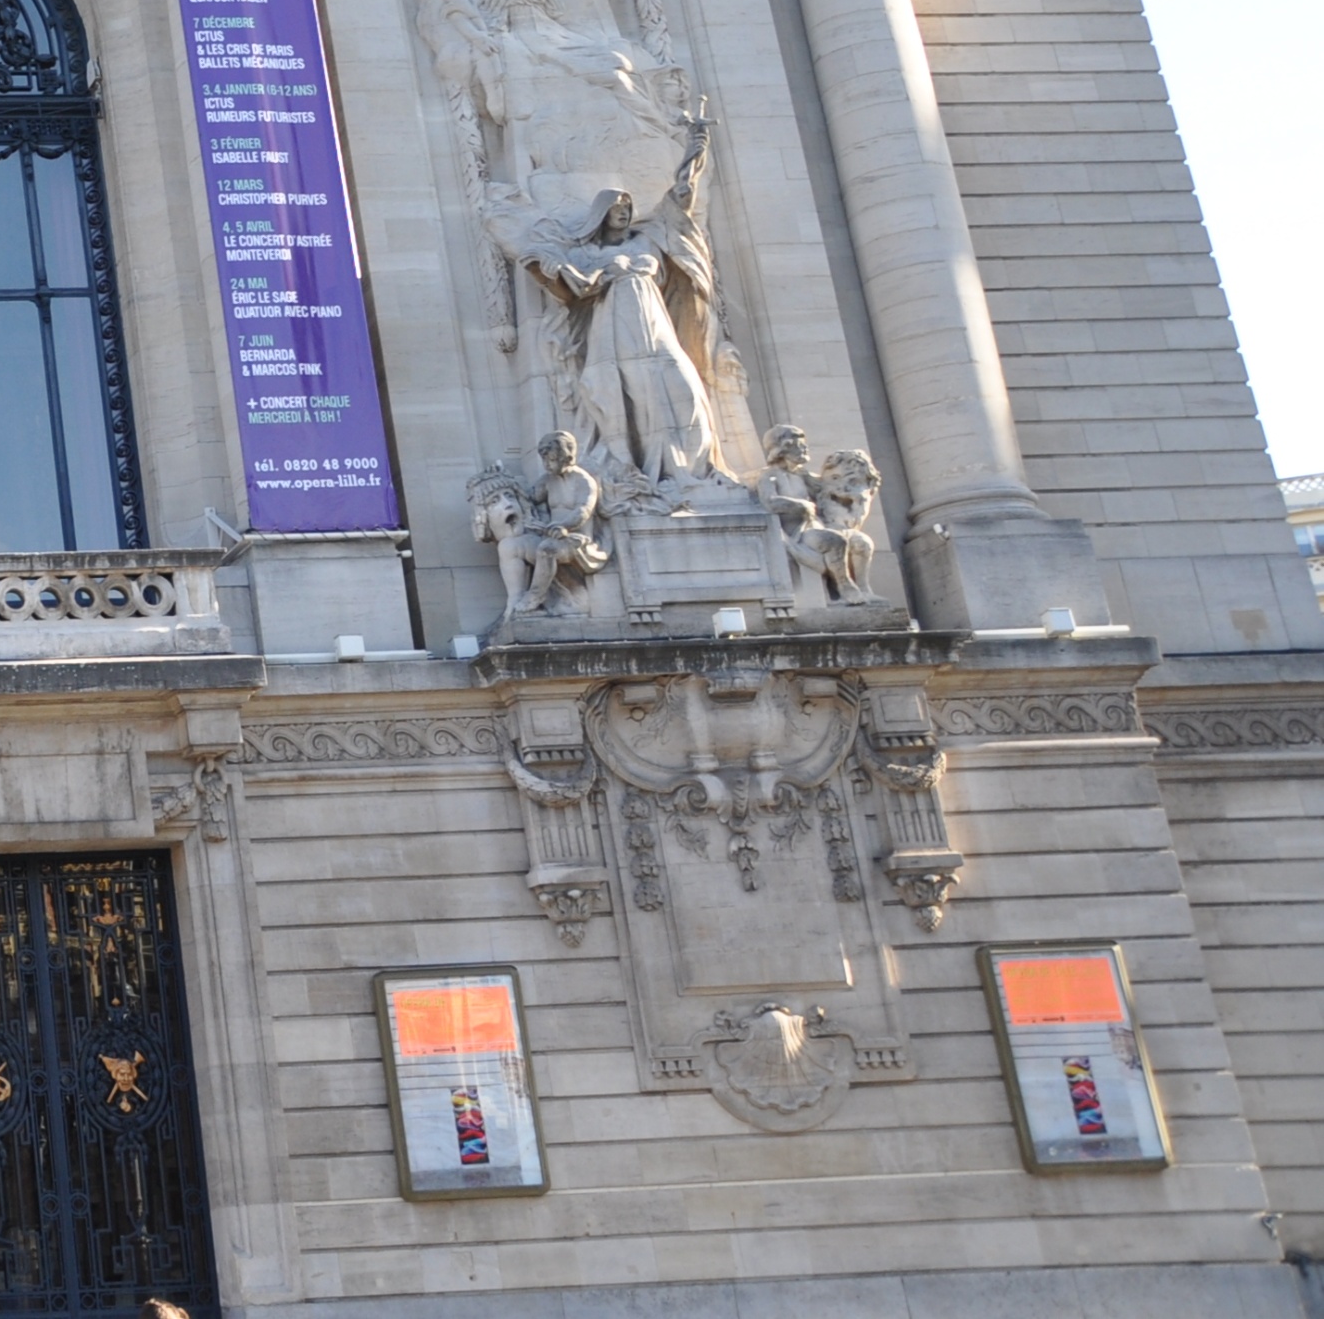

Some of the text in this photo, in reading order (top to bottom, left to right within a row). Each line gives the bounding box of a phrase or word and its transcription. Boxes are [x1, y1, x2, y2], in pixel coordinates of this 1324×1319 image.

[199, 56, 305, 69] BALLETS MÉCANIQUES
[207, 110, 315, 123] RUMEURS FUTURISTES
[213, 151, 289, 163] ISABELLE FAUST
[218, 192, 327, 205] CHRISTOPHER PURVES
[227, 249, 292, 261] MONTEVERDI
[234, 306, 341, 318] QUATUOR AVEC PIANO
[240, 349, 296, 362] BERNARDA
[252, 363, 297, 375] MARCOS
[299, 363, 322, 375] FINK
[260, 396, 308, 410] CONCERT
[310, 396, 350, 408] CHAQUE
[249, 411, 301, 423] MERCREDI
[304, 410, 311, 422] À
[315, 411, 335, 422] 18H
[254, 458, 378, 471] tél. 0820 48 9000
[257, 473, 381, 491] www.opera-lille.fr
